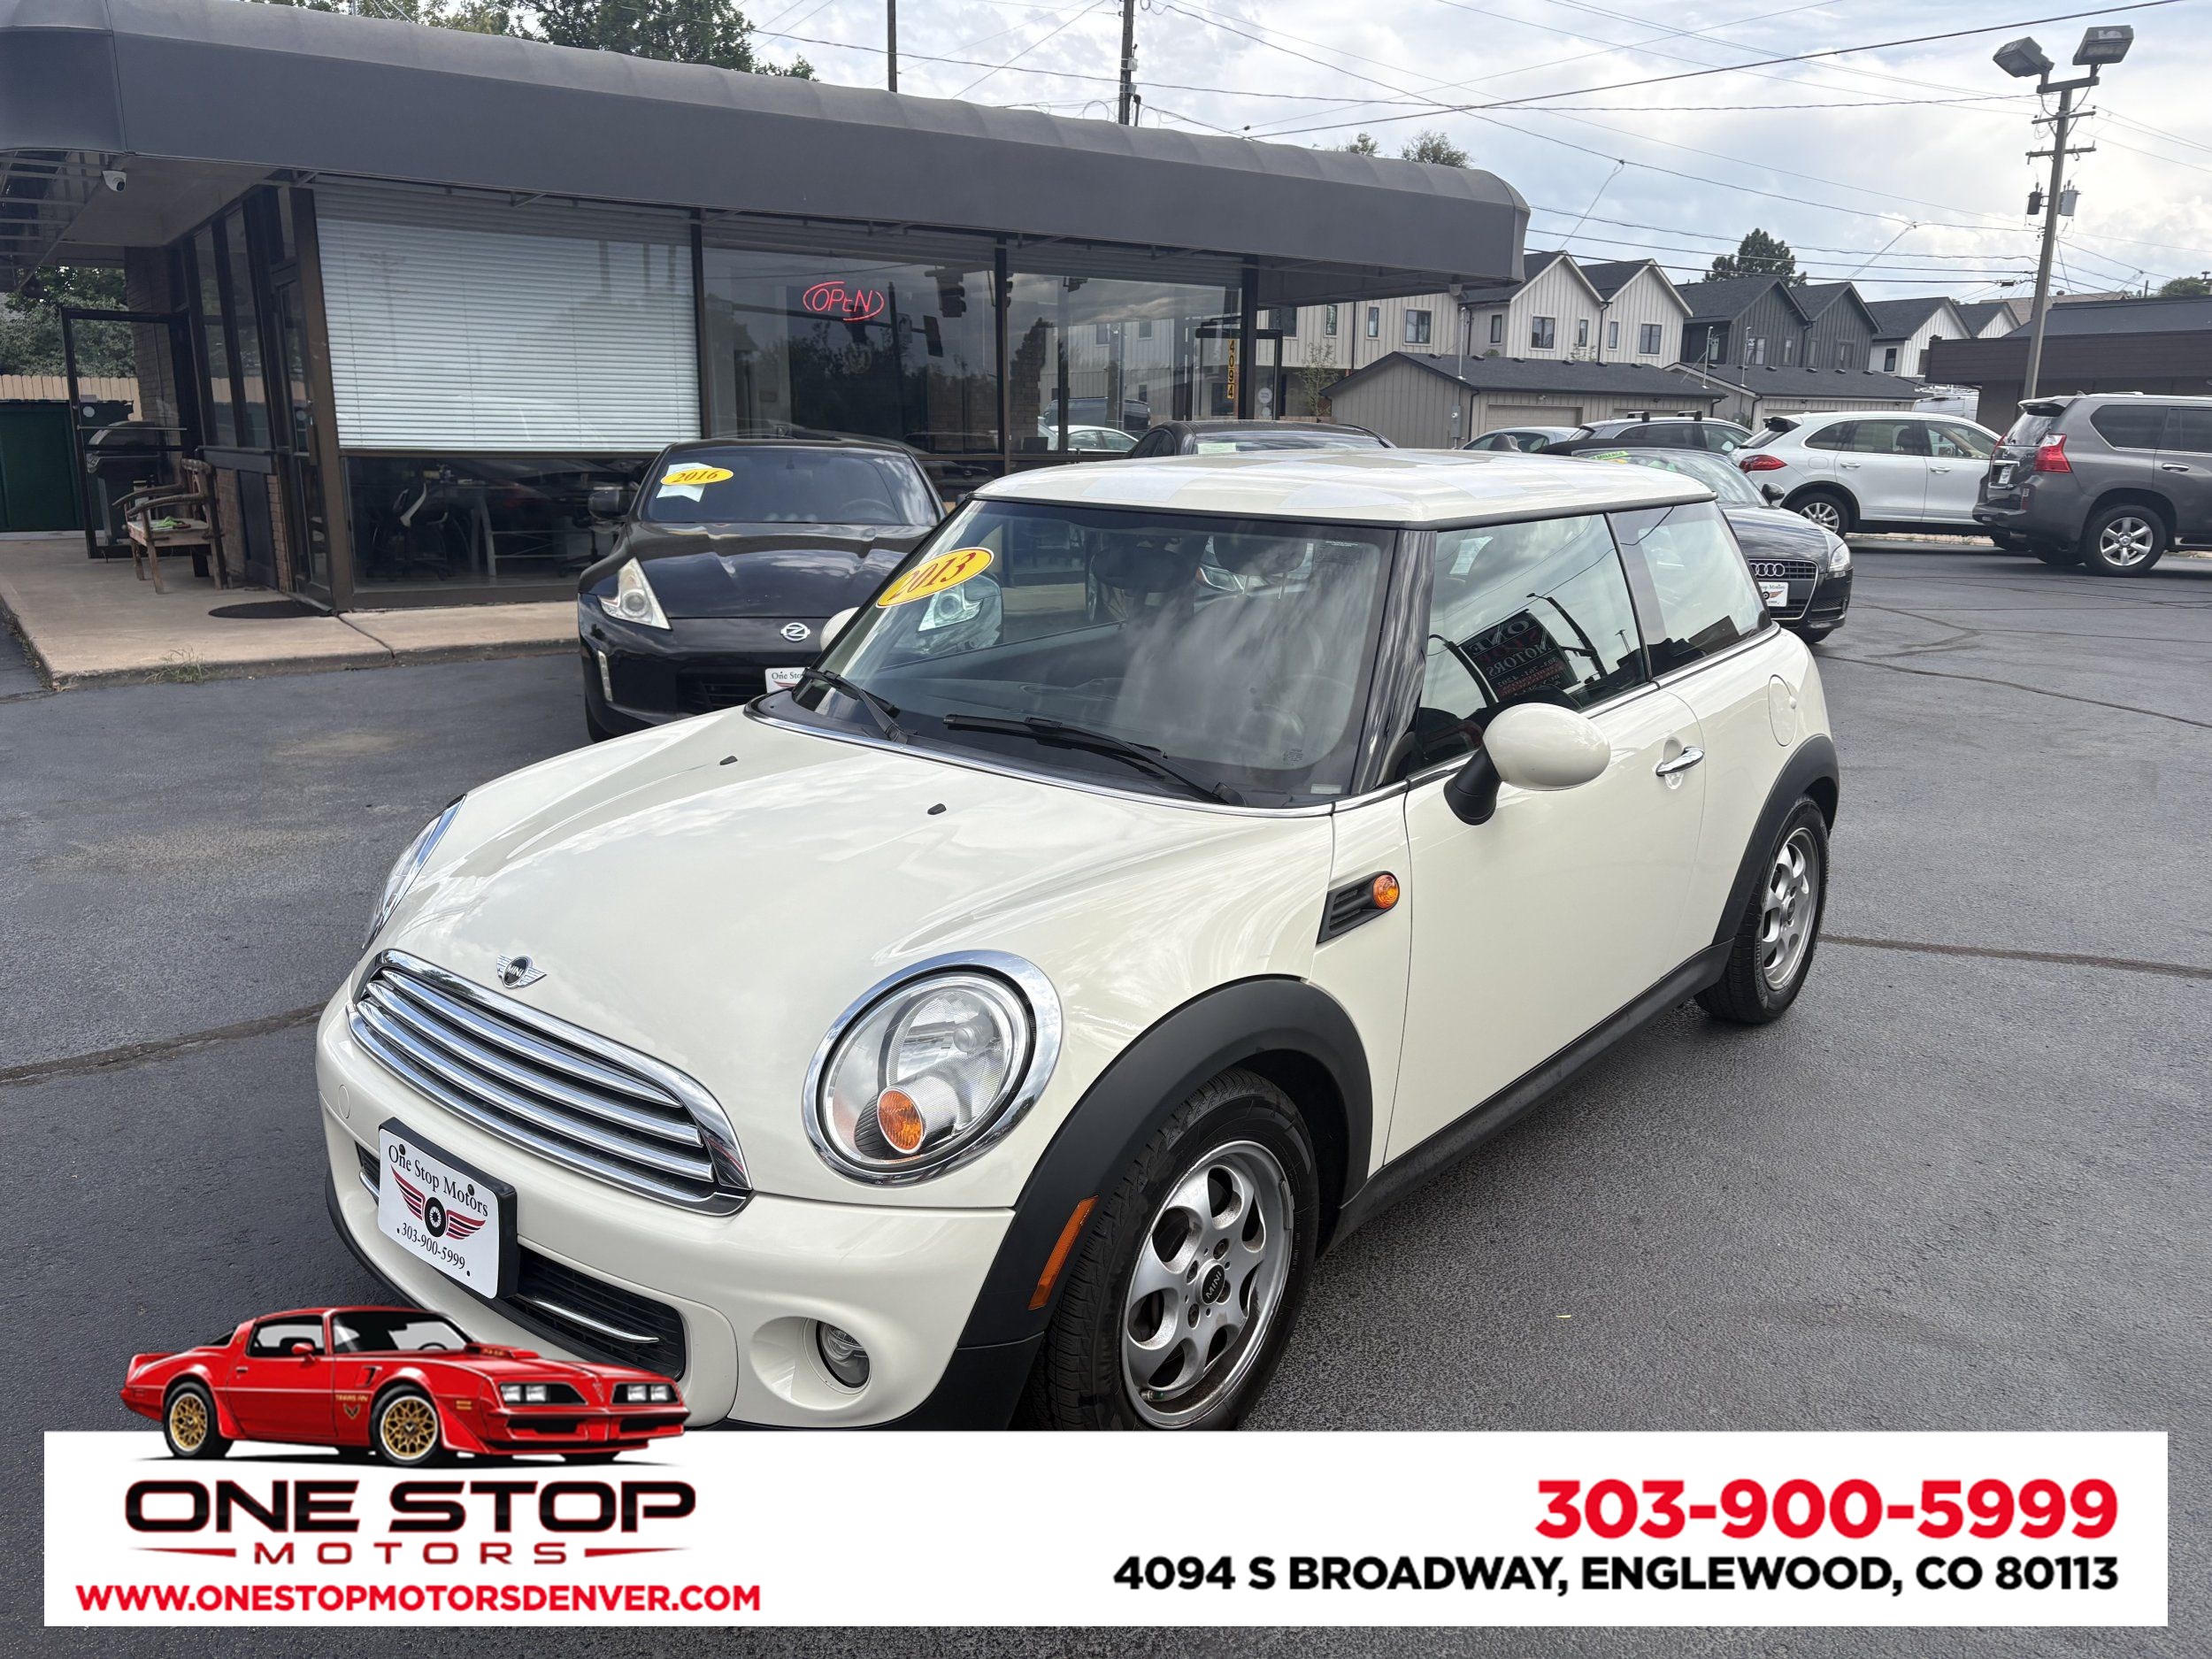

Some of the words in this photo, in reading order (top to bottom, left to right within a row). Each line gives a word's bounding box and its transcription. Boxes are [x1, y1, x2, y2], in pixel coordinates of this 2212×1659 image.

[812, 288, 872, 312] OPEN
[672, 470, 719, 483] 2016
[887, 552, 977, 602] 2013
[388, 1144, 412, 1172] One
[415, 1160, 440, 1193] Stop
[443, 1176, 488, 1217] Motors
[402, 1222, 465, 1270] 303-900-5999
[1205, 1271, 1221, 1299] MINI
